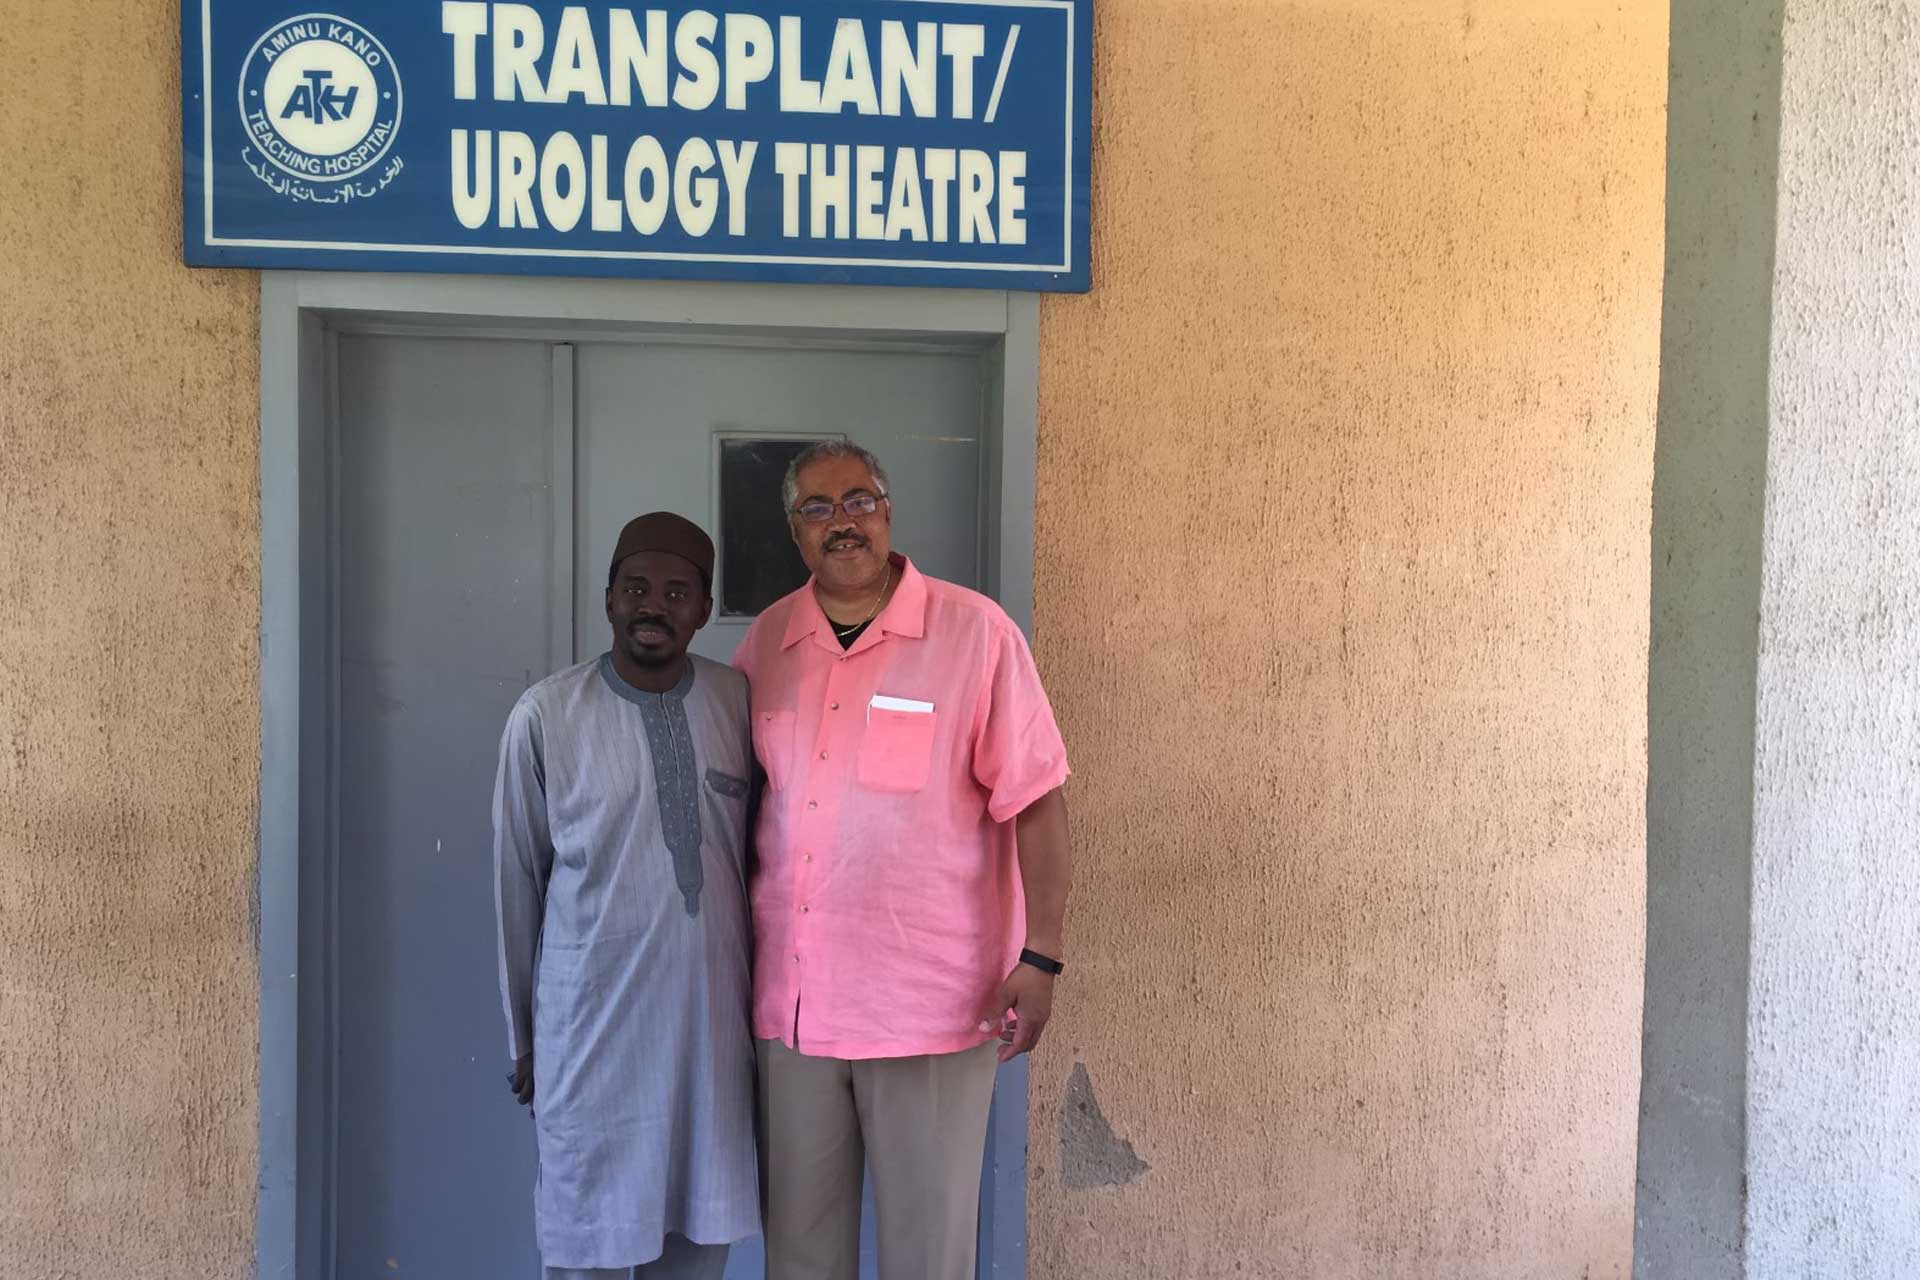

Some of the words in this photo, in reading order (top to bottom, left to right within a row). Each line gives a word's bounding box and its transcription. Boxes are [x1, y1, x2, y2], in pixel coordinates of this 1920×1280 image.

[262, 22, 320, 62] AMINU
[328, 24, 381, 67] KANO
[442, 1, 1021, 123] TRANSPLANT/
[249, 108, 320, 174] TEACHING
[325, 120, 392, 174] HOSPITAL
[452, 129, 758, 236] UROLOGY
[775, 143, 1026, 244] THEATRE
